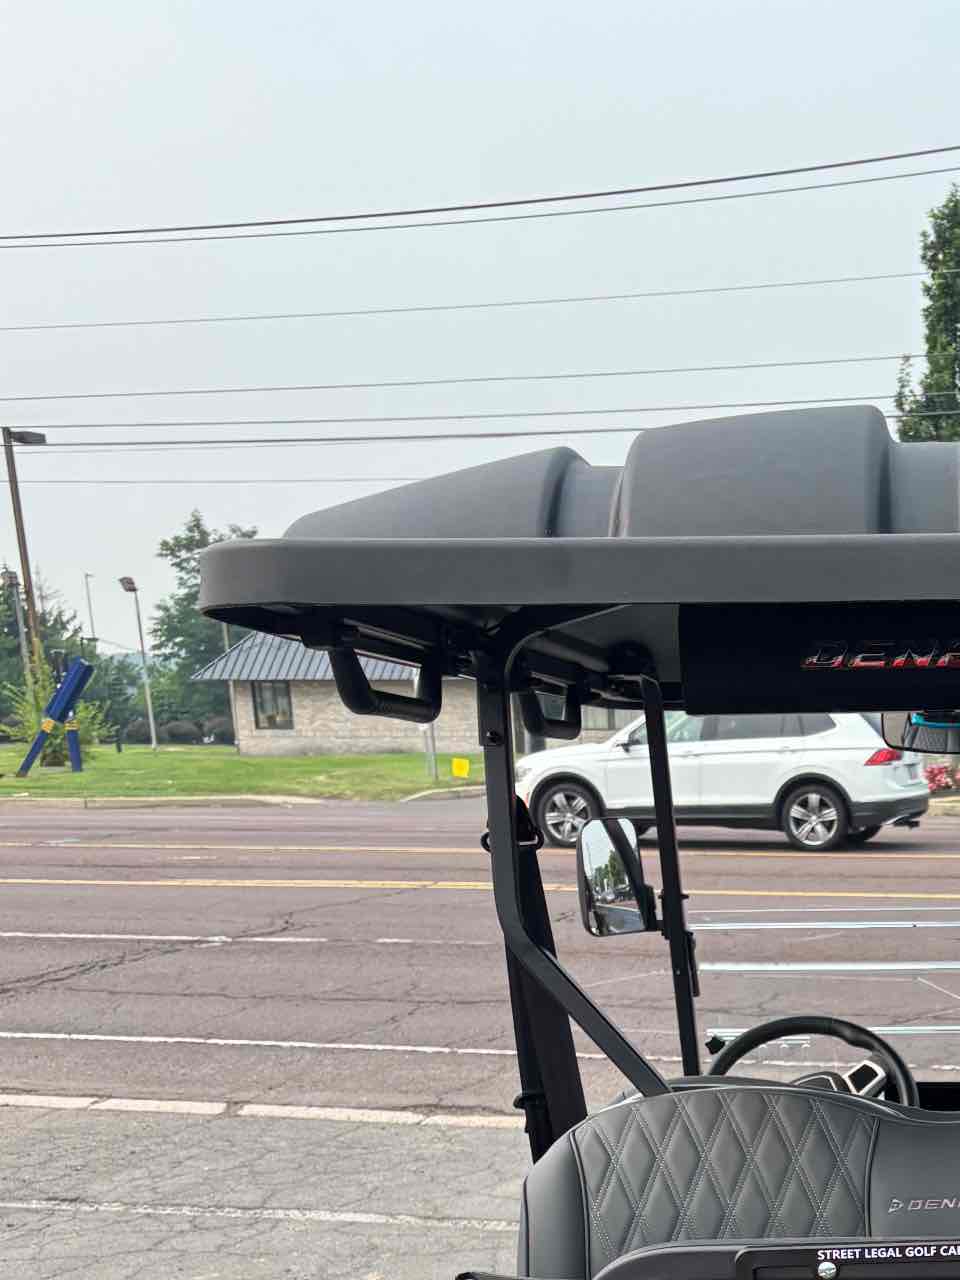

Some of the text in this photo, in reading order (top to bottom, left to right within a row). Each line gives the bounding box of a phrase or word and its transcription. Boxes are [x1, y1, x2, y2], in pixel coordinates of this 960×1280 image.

[817, 1247, 861, 1260] STREET
[864, 1246, 902, 1259] LEGAL
[905, 1245, 937, 1258] GOLF
